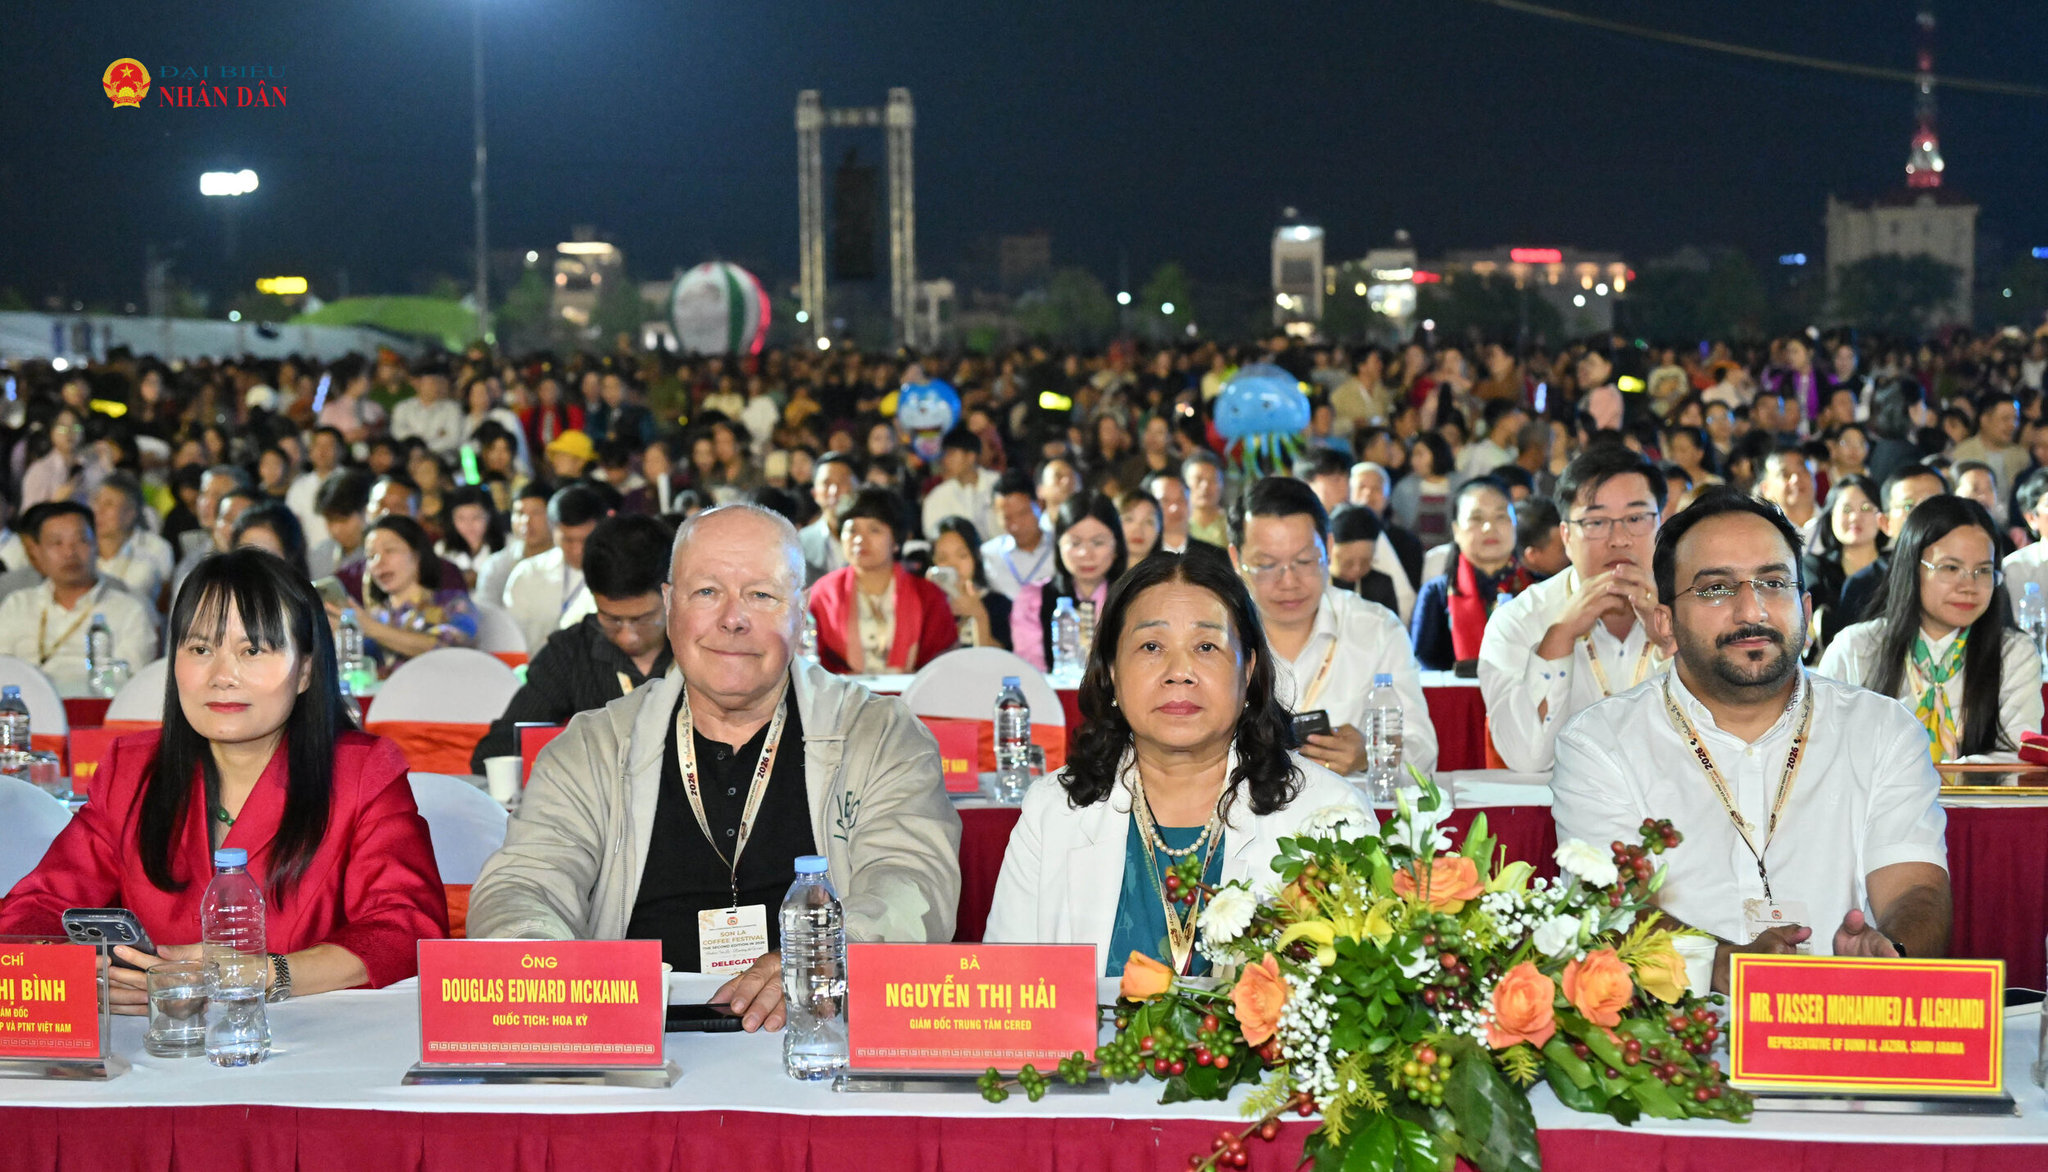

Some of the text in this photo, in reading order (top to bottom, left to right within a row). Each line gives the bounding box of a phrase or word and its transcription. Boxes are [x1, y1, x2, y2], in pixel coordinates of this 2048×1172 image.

[756, 756, 770, 779] 2026
[1694, 747, 1714, 771] 2026
[1786, 746, 1799, 770] 2026
[689, 772, 699, 797] 2026
[702, 934, 765, 946] COFFEE FESTIVAL
[1, 951, 25, 967] CHÍ
[521, 953, 558, 969] ÔNG
[960, 954, 981, 971] BÀ
[0, 973, 66, 1006] HỊ BÌNH
[441, 978, 639, 1004] DOUGLAS EDWARD MCKANNA
[885, 974, 1057, 1015] NGUYỄN THỊ HẢI
[13, 1005, 29, 1018] ĐỐC
[492, 1011, 520, 1026] QUỐC
[522, 1014, 550, 1028] TỊCH:
[552, 1015, 573, 1026] HOA
[1749, 992, 1985, 1029] MR. YASSER MOHAMMED A. ALGHAMDI
[6, 1020, 16, 1032] VÀ
[17, 1022, 36, 1032] PTNT
[37, 1021, 54, 1034] VIỆT
[54, 1023, 72, 1033] NAM
[909, 1015, 1032, 1031] GIÁM ĐỐC TRUNG TÂM CERED
